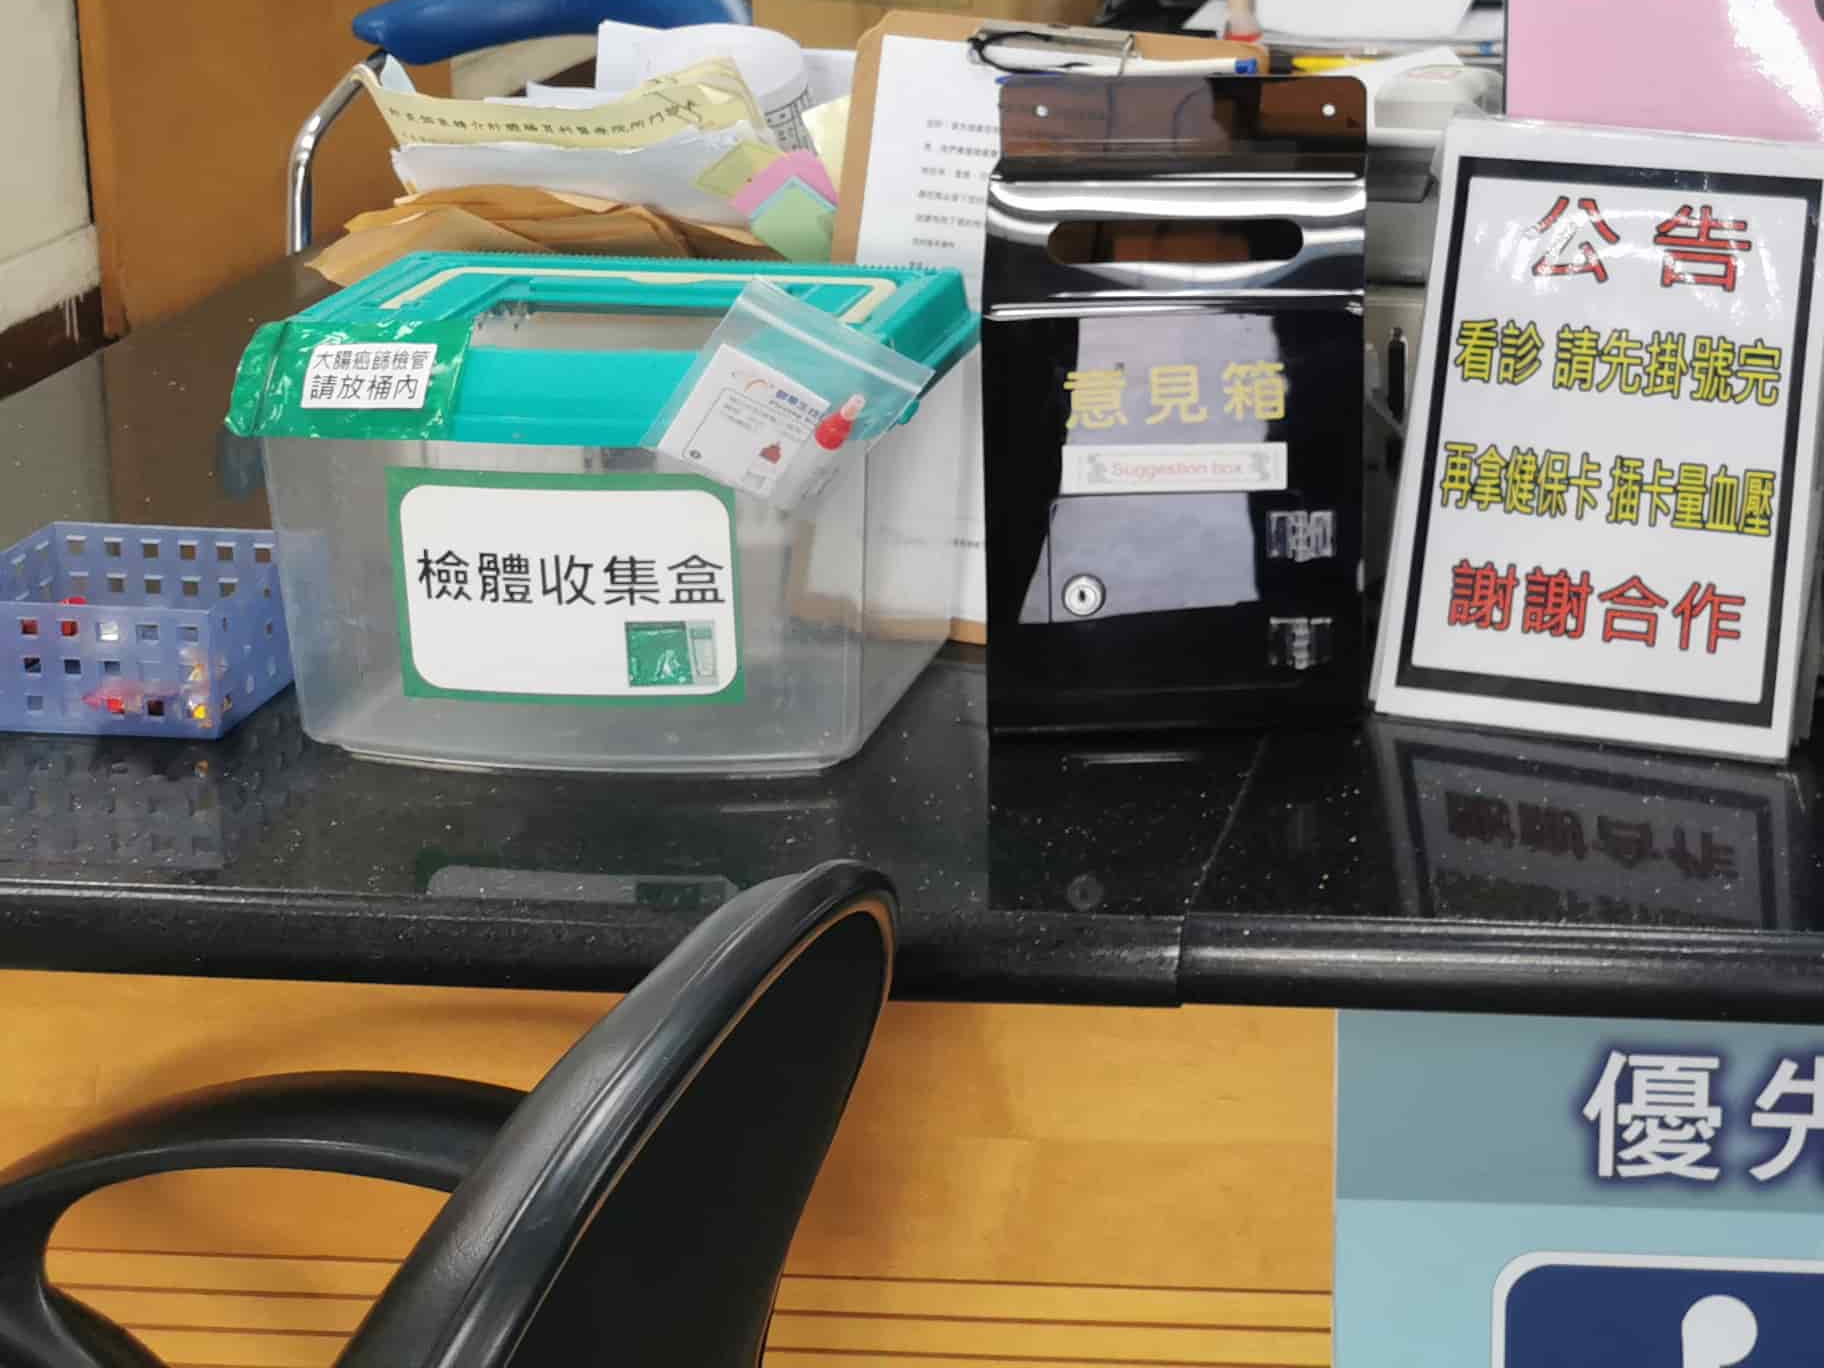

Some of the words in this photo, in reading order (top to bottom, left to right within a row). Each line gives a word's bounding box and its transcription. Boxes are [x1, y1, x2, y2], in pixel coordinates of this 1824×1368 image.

[1531, 196, 1752, 292] 公告
[309, 374, 419, 401] 請放桶內
[1063, 360, 1287, 430] 意見箱
[1551, 326, 1782, 406] 請先掛號完
[1111, 462, 1208, 480] Suggestion
[415, 547, 727, 608] 檢體收集盒
[1447, 559, 1746, 653] 謝謝合作
